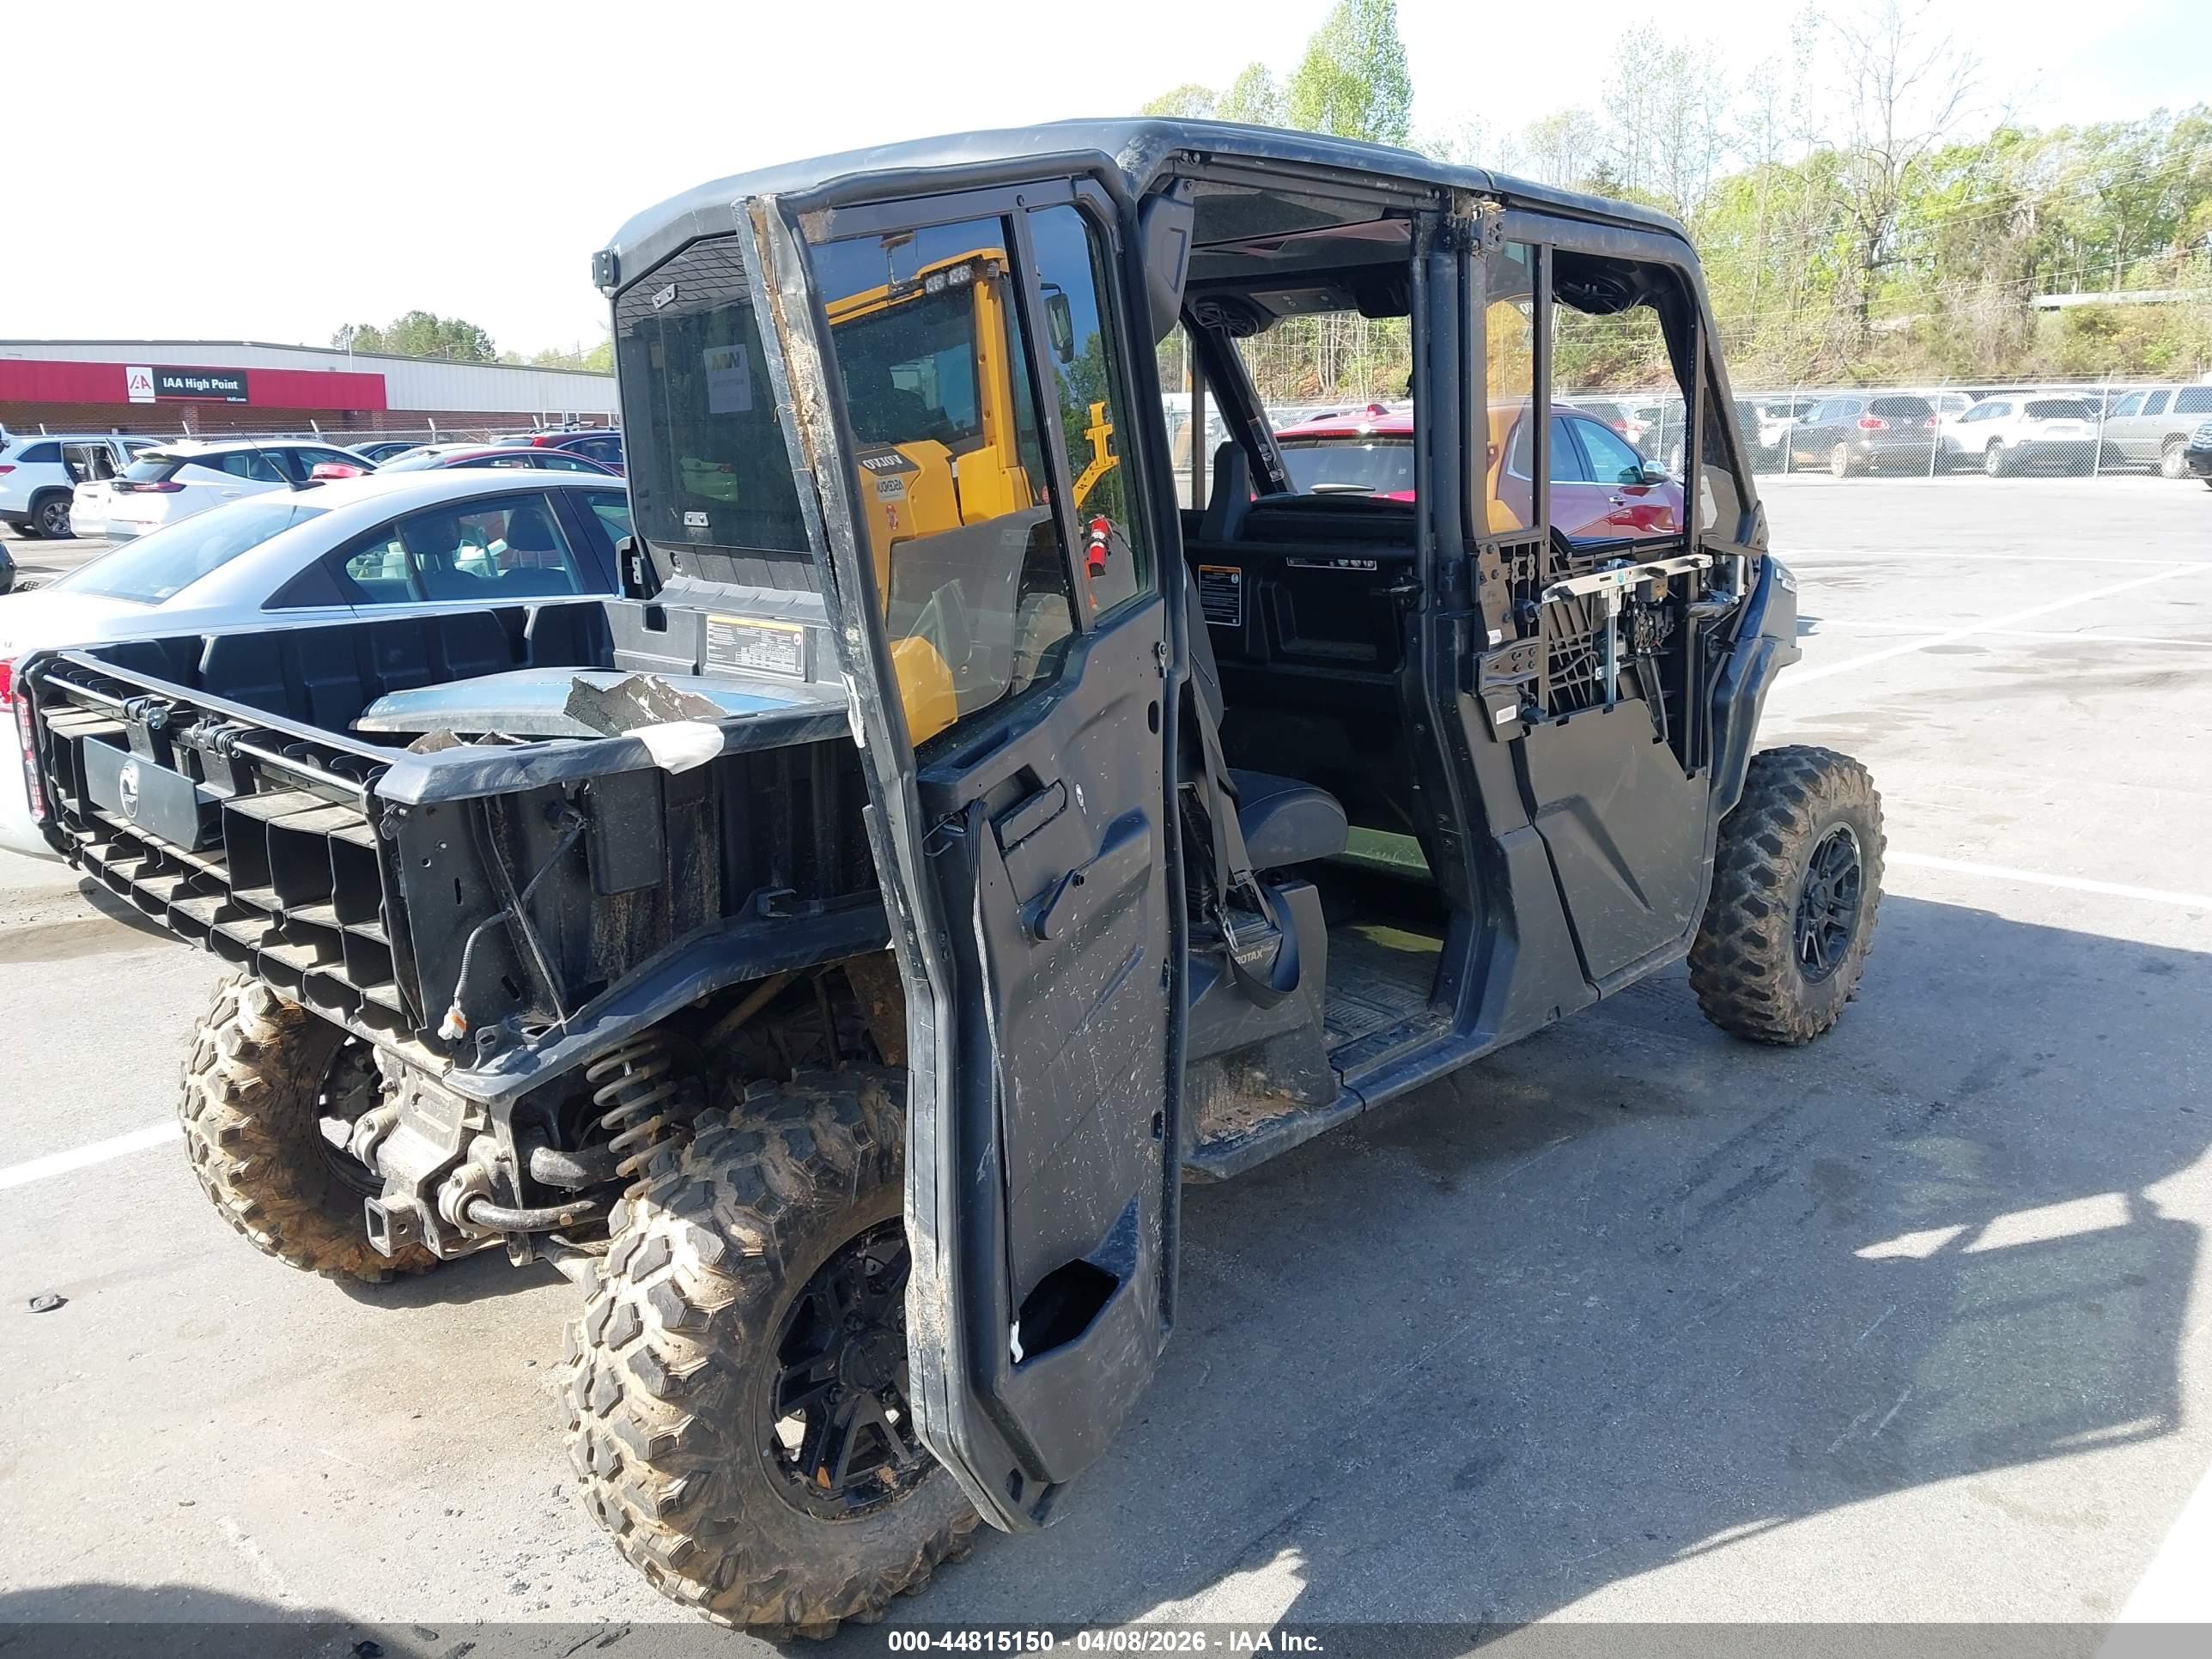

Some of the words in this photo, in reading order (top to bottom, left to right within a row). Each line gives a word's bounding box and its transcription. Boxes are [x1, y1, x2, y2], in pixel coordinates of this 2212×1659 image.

[162, 377, 184, 388] IAA
[185, 378, 210, 391] High
[211, 379, 239, 390] Point
